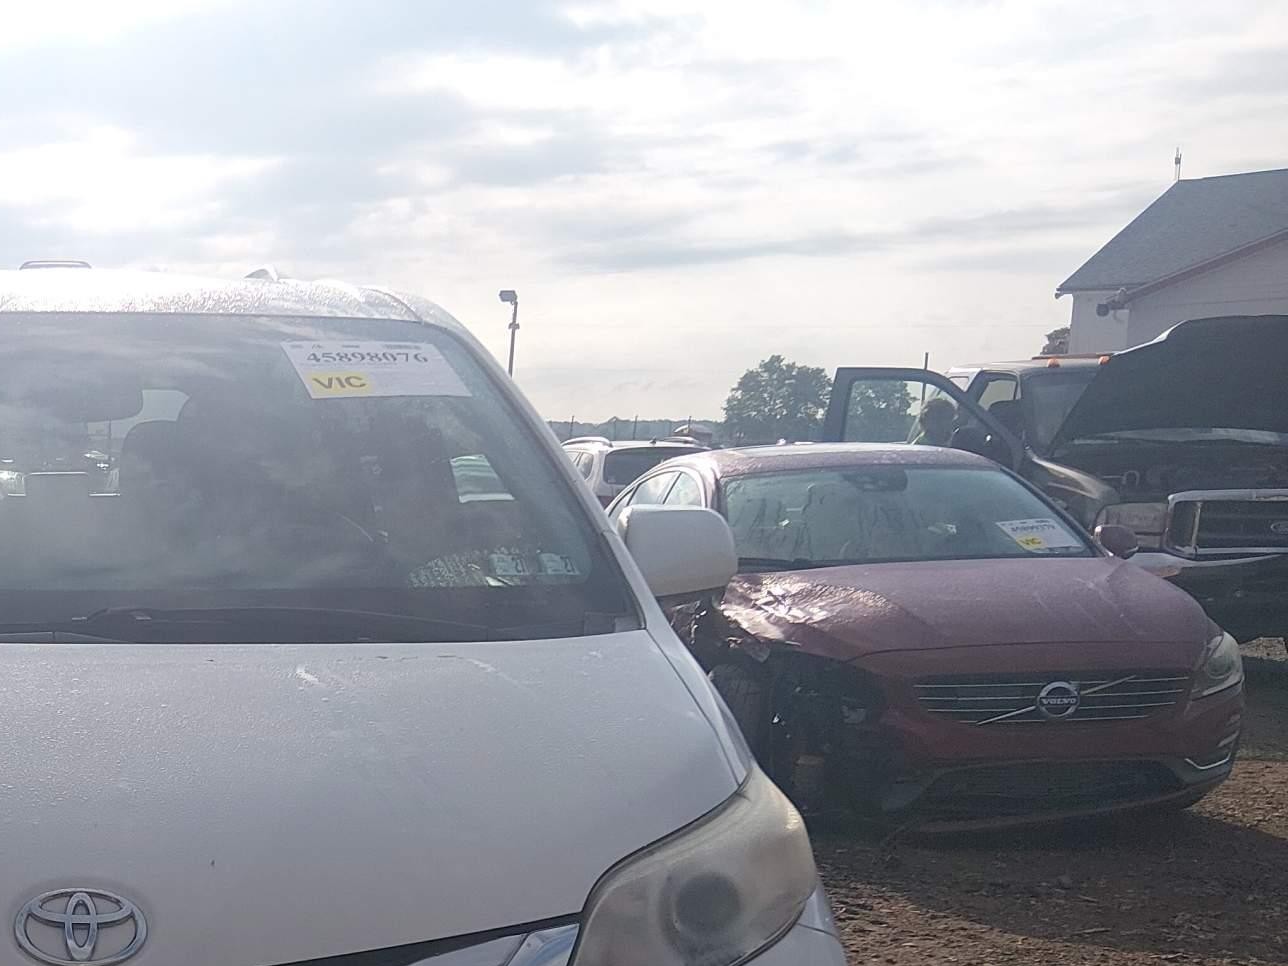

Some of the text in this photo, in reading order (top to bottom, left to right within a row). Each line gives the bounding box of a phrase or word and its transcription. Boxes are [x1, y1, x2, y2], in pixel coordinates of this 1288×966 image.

[306, 351, 429, 363] 45898076
[311, 375, 367, 390] VIC
[1041, 697, 1077, 705] VOLVO
